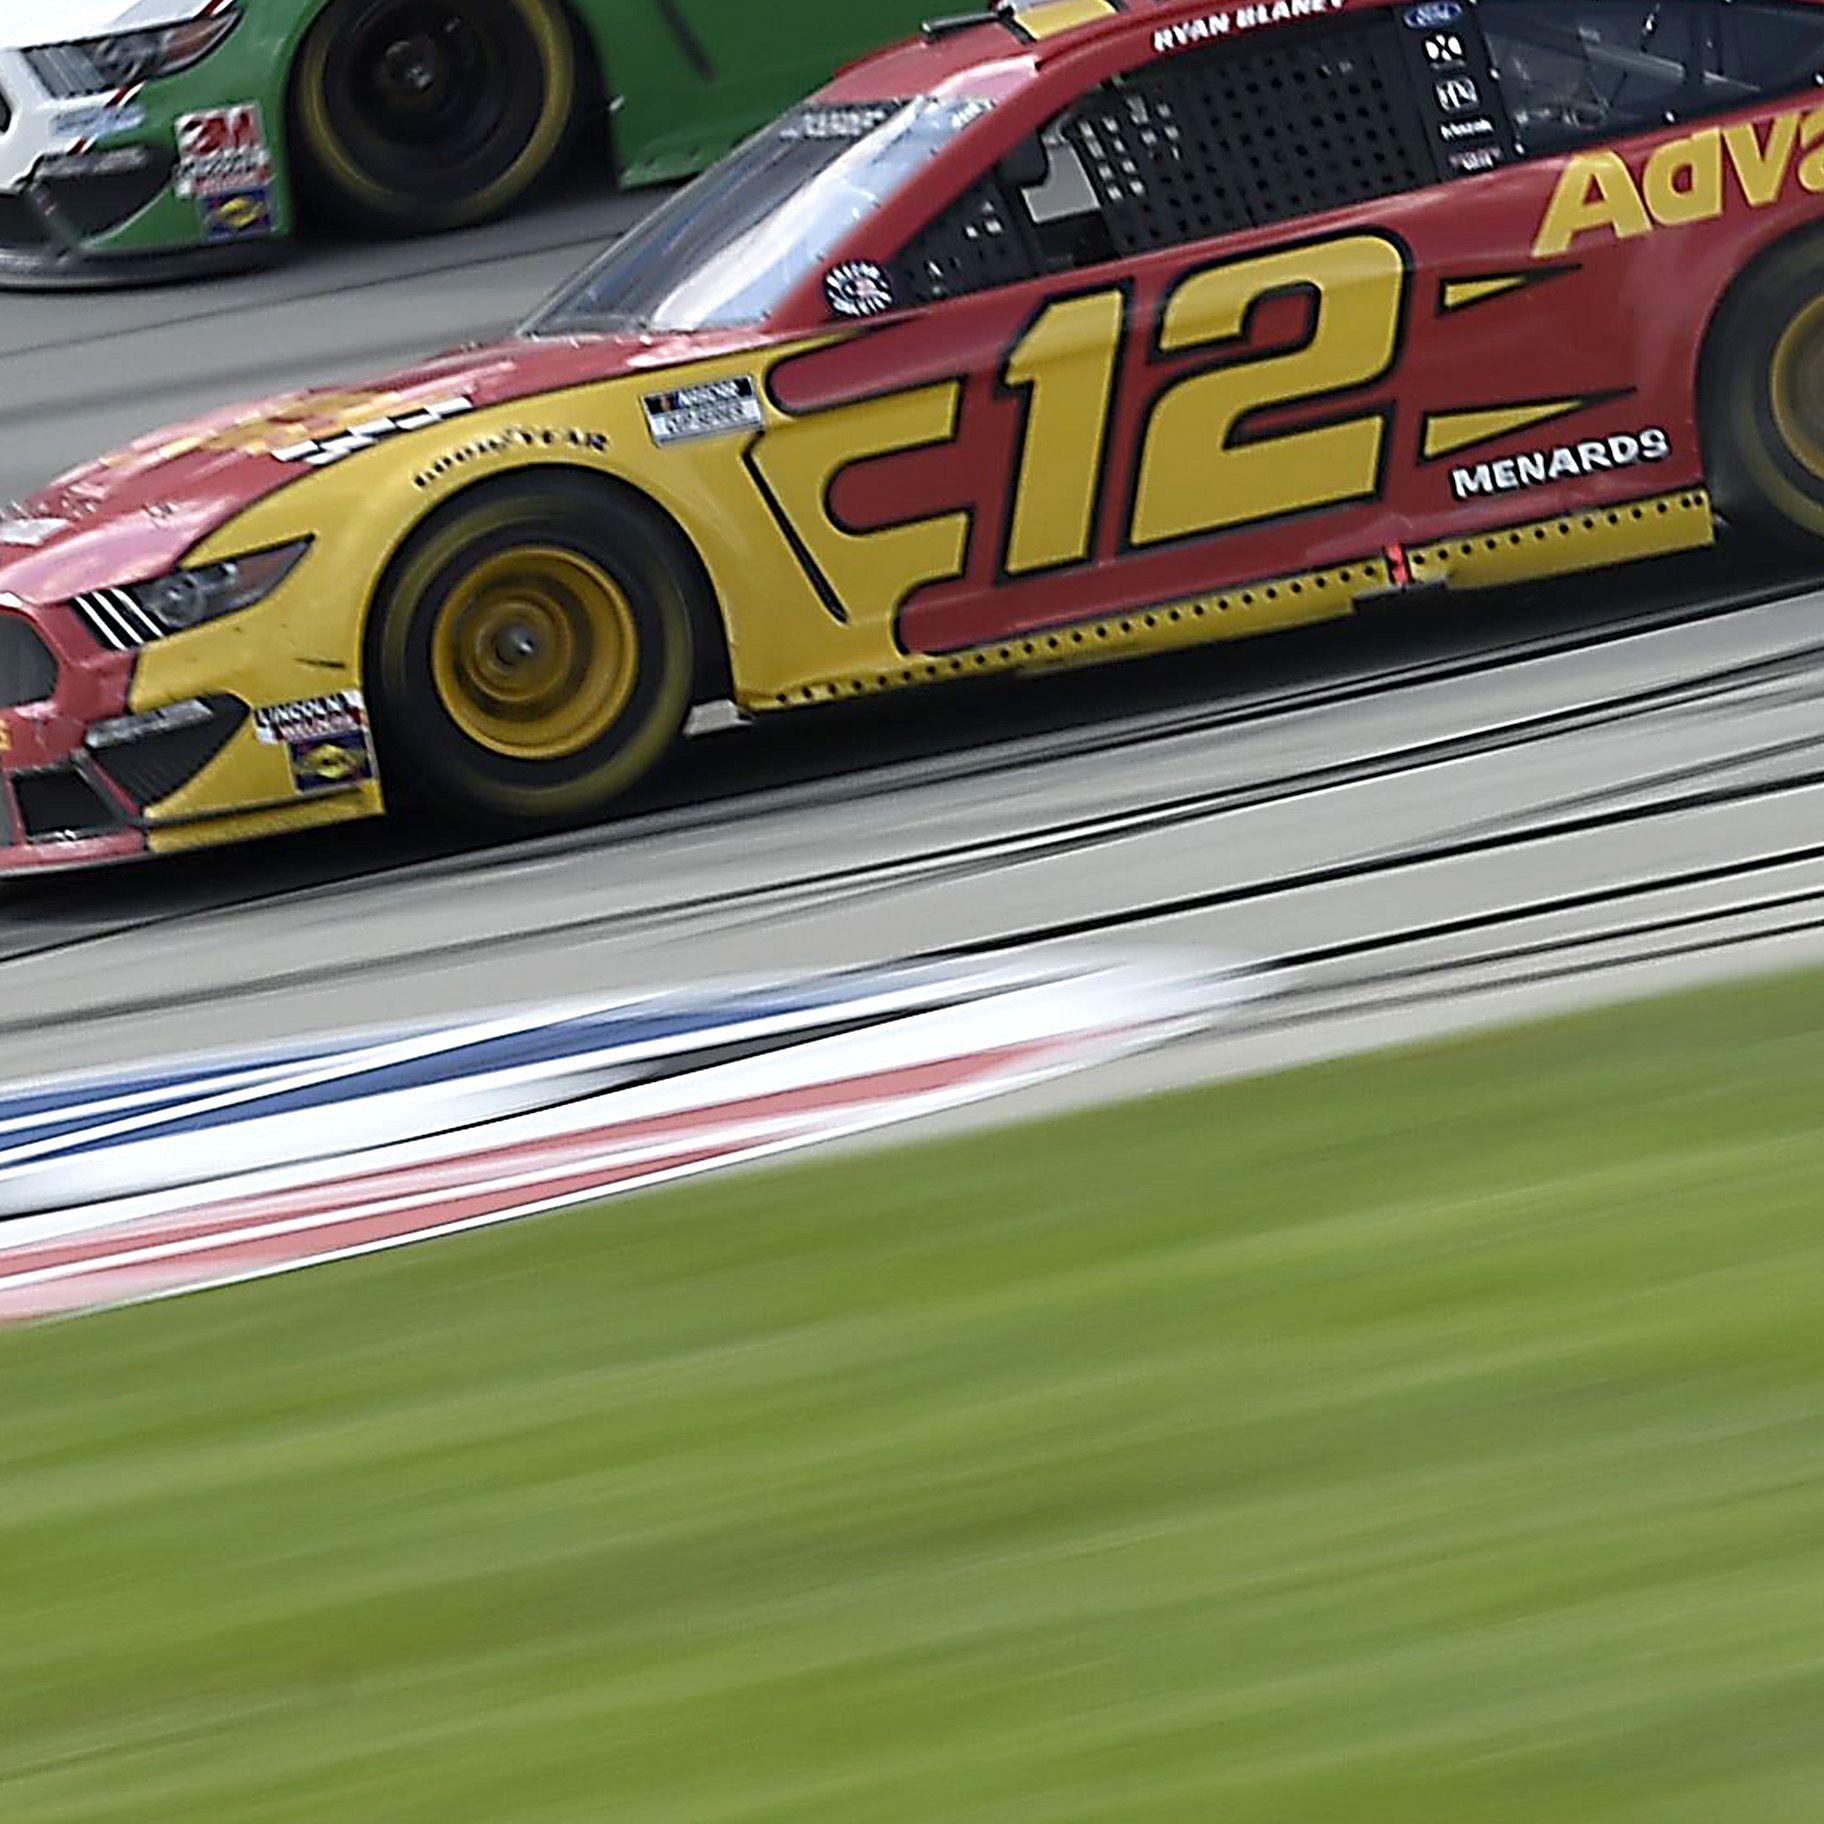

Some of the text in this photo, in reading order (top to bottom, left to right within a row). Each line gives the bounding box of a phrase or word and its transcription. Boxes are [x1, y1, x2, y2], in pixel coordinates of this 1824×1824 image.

[1153, 13, 1230, 53] RYAN
[178, 106, 262, 156] 3M
[998, 232, 1408, 576] 12
[1451, 427, 1670, 499] MENARDS
